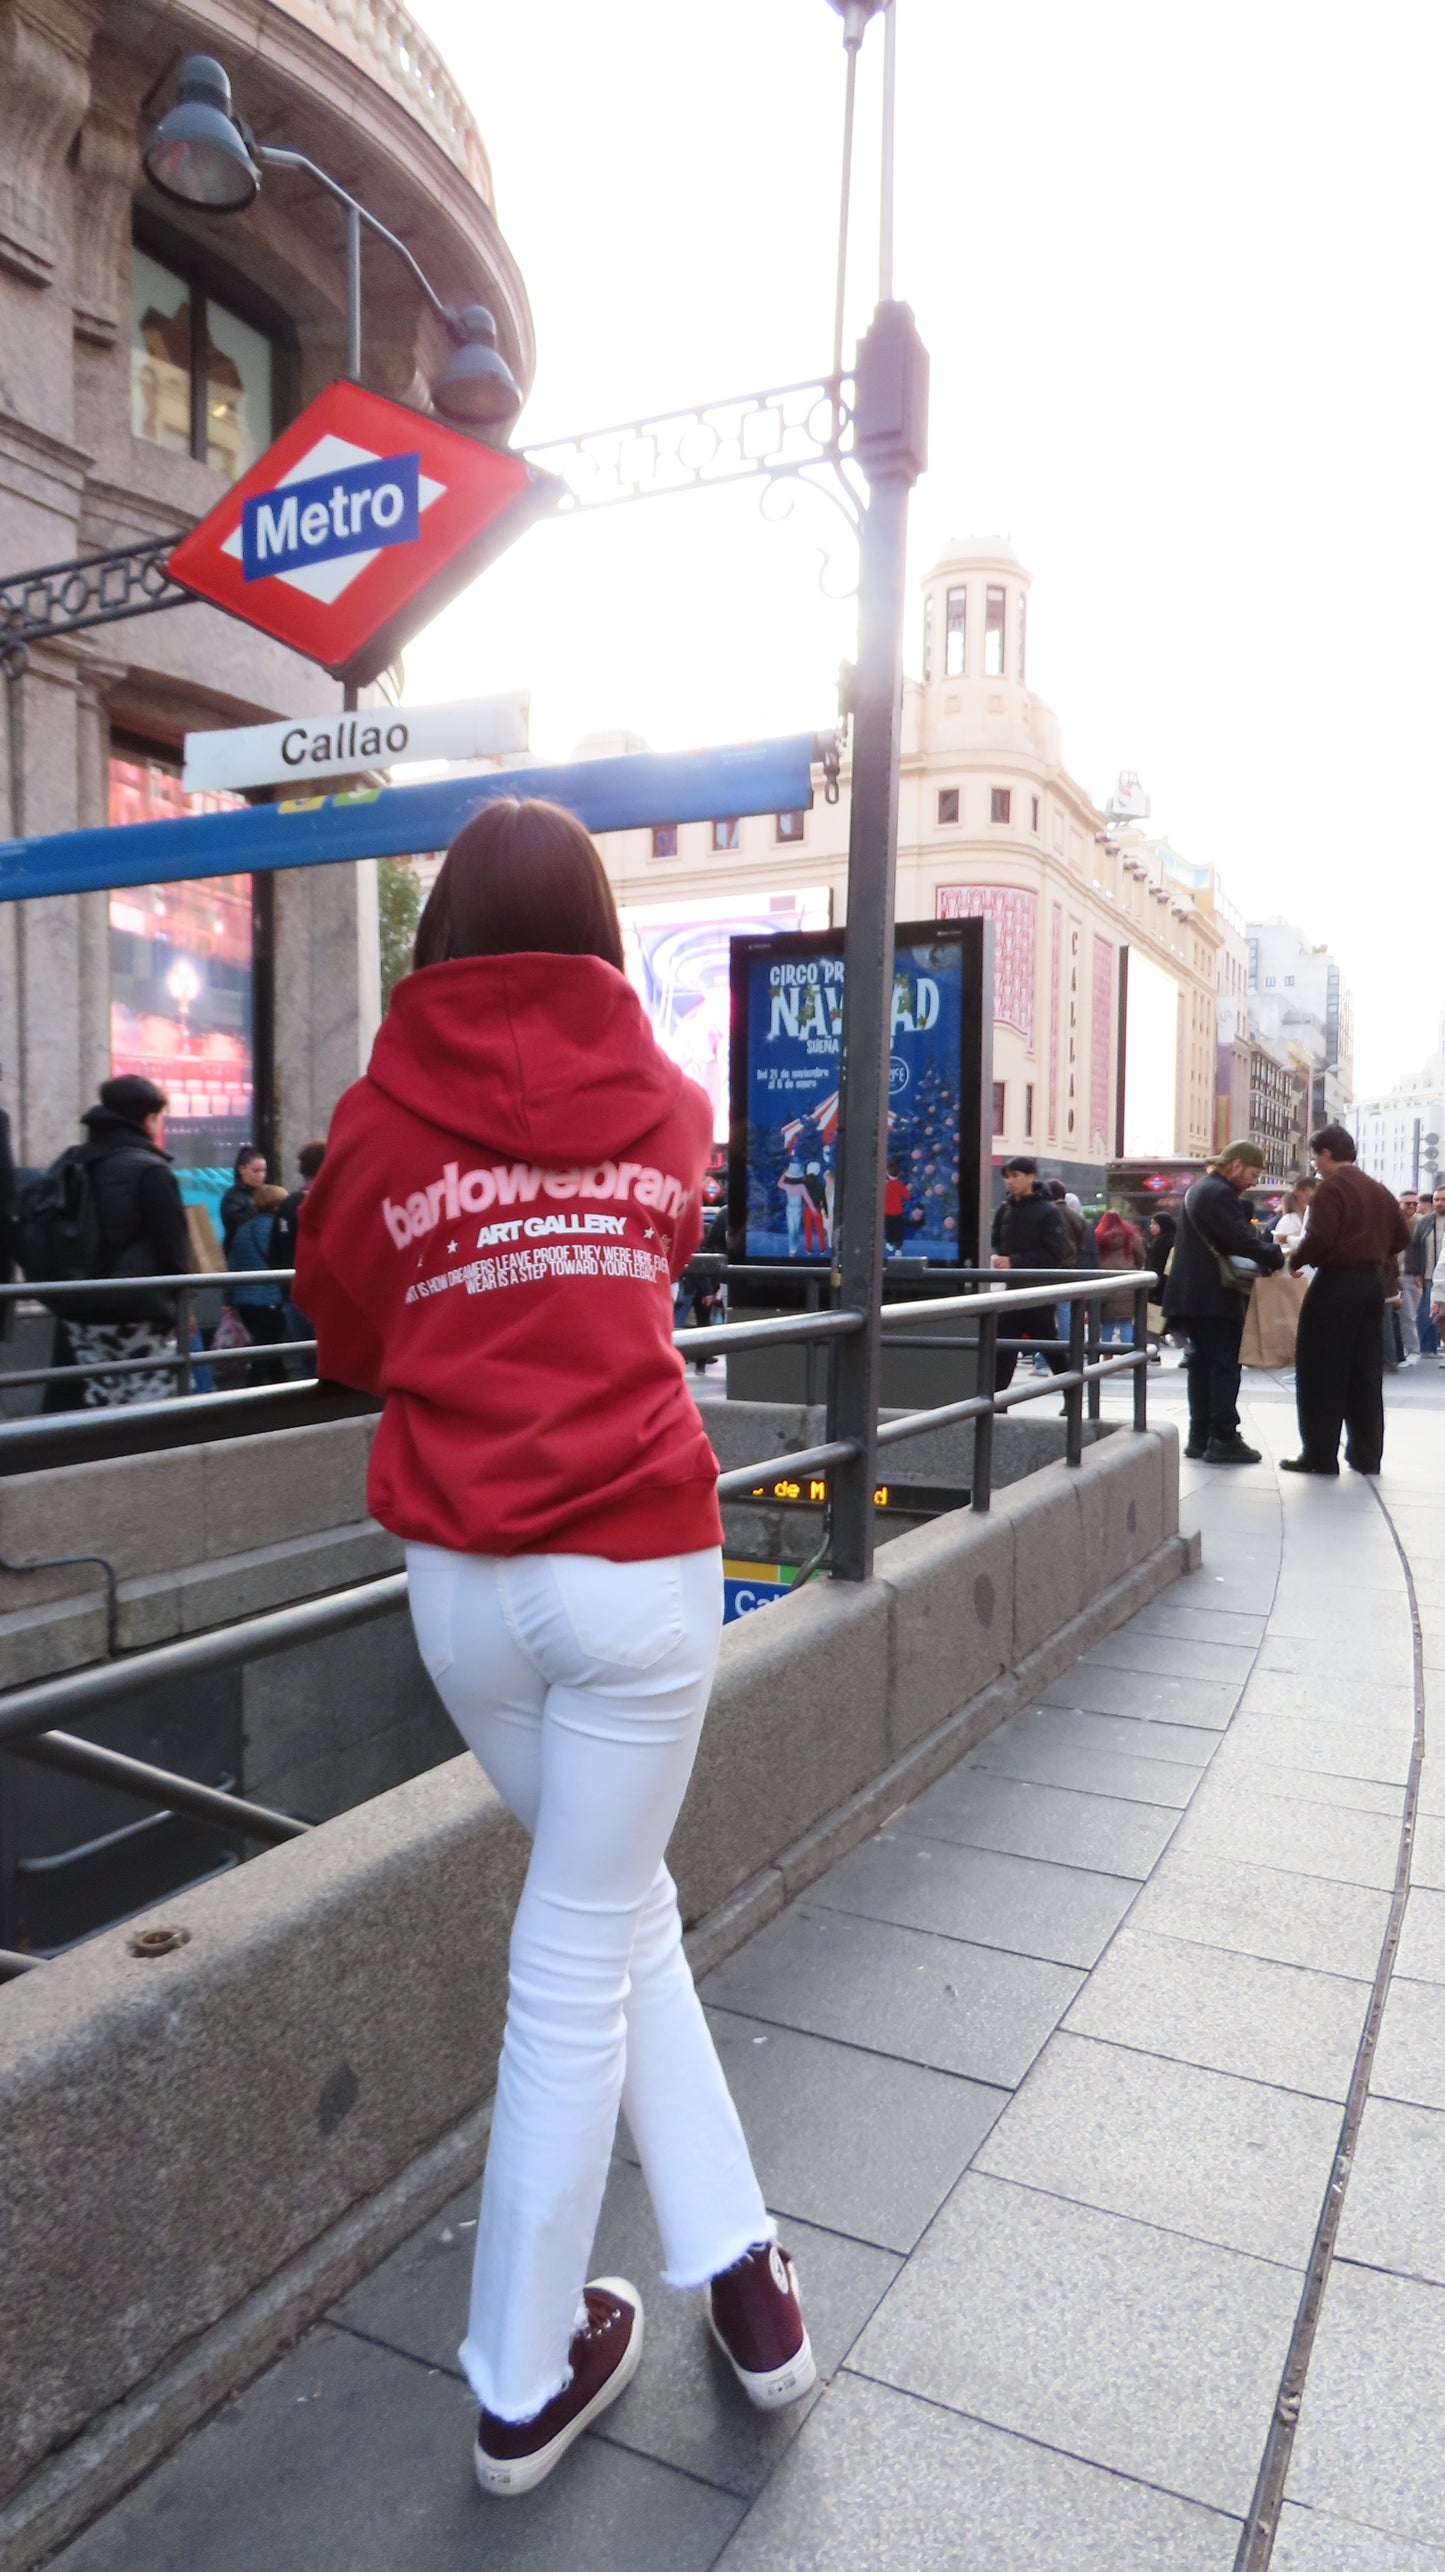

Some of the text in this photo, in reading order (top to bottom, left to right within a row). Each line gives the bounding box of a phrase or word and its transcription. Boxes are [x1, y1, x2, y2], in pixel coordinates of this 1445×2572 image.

[257, 482, 405, 560] Metro
[281, 721, 408, 766] Callao
[769, 962, 818, 986] CIRCO
[769, 977, 940, 1041] NAVAD
[807, 1035, 840, 1054] SUEÑA
[1067, 930, 1078, 1134] CALLAO
[476, 1213, 627, 1249] ART GALLERY
[447, 1258, 496, 1287] DREAMERS
[495, 1249, 532, 1272] LEAVE
[532, 1245, 570, 1266] PROOF
[572, 1244, 602, 1261] THEY
[603, 1245, 633, 1264] WERE
[464, 1273, 498, 1295] WEAR
[497, 1270, 509, 1288] IS
[510, 1270, 519, 1285] A
[519, 1262, 548, 1282] STEP
[550, 1259, 599, 1276] TOWARD
[600, 1258, 628, 1277] YOUR
[774, 1480, 800, 1499] de
